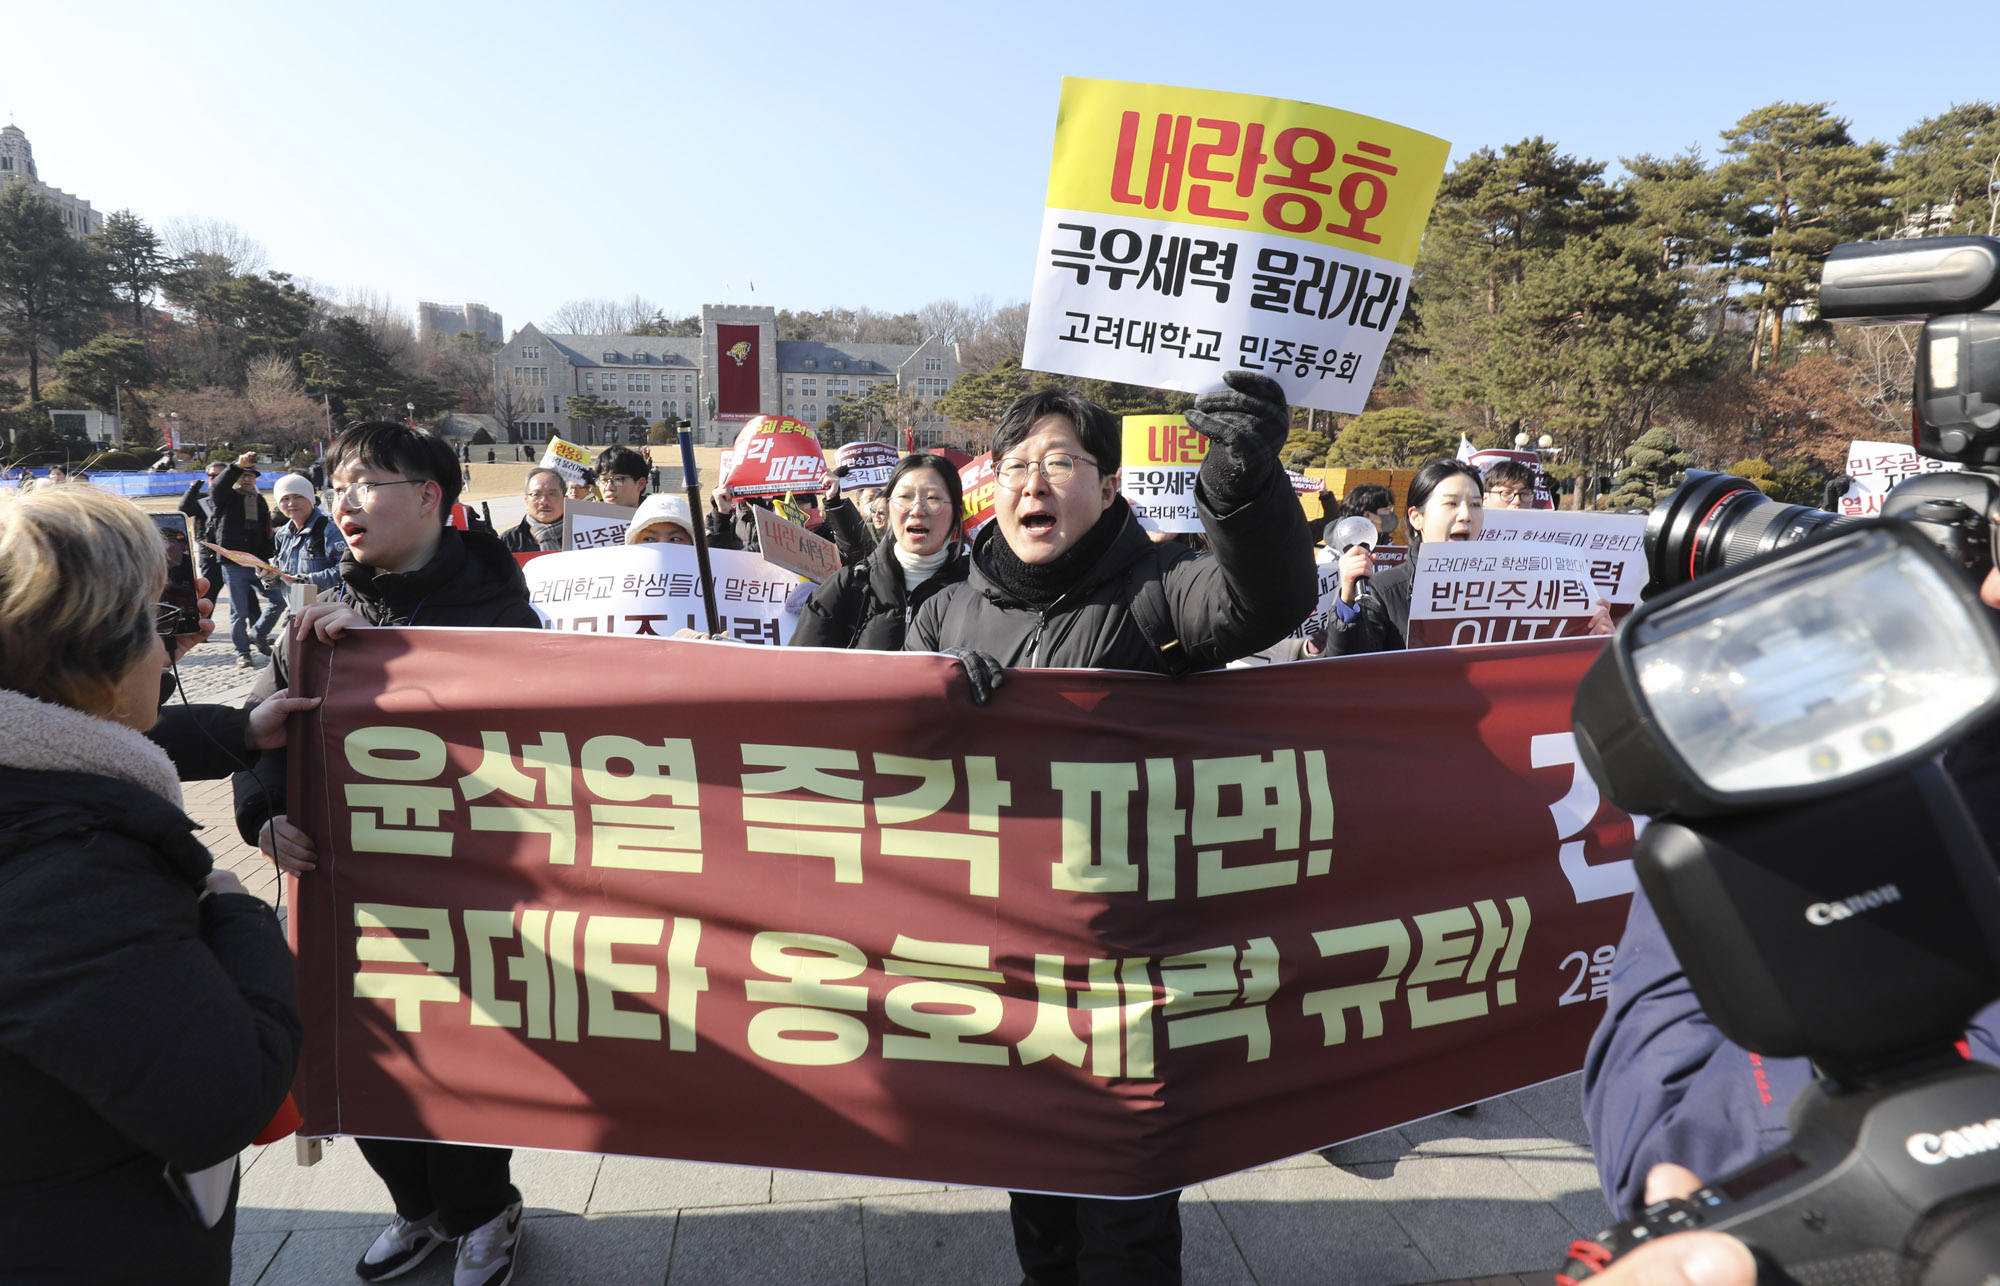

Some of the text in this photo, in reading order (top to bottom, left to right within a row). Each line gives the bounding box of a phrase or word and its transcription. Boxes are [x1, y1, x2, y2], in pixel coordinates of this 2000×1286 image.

[1110, 110, 1398, 245] 내란옹호
[1051, 222, 1402, 332] 극우세력 물러가라
[1059, 311, 1362, 384] 고려대학교 민주동우회
[573, 523, 632, 550] 민주광
[1423, 557, 1497, 574] 고려대학교
[1501, 556, 1552, 572] 학생들이
[531, 576, 615, 603] 려대학교
[1431, 579, 1590, 612] 반민주세력
[343, 725, 1334, 902] 윤석열 즉각 파면!
[1805, 884, 1902, 926] Canon
[353, 895, 1532, 1079] 쿠데타 옹호세력 규탄!
